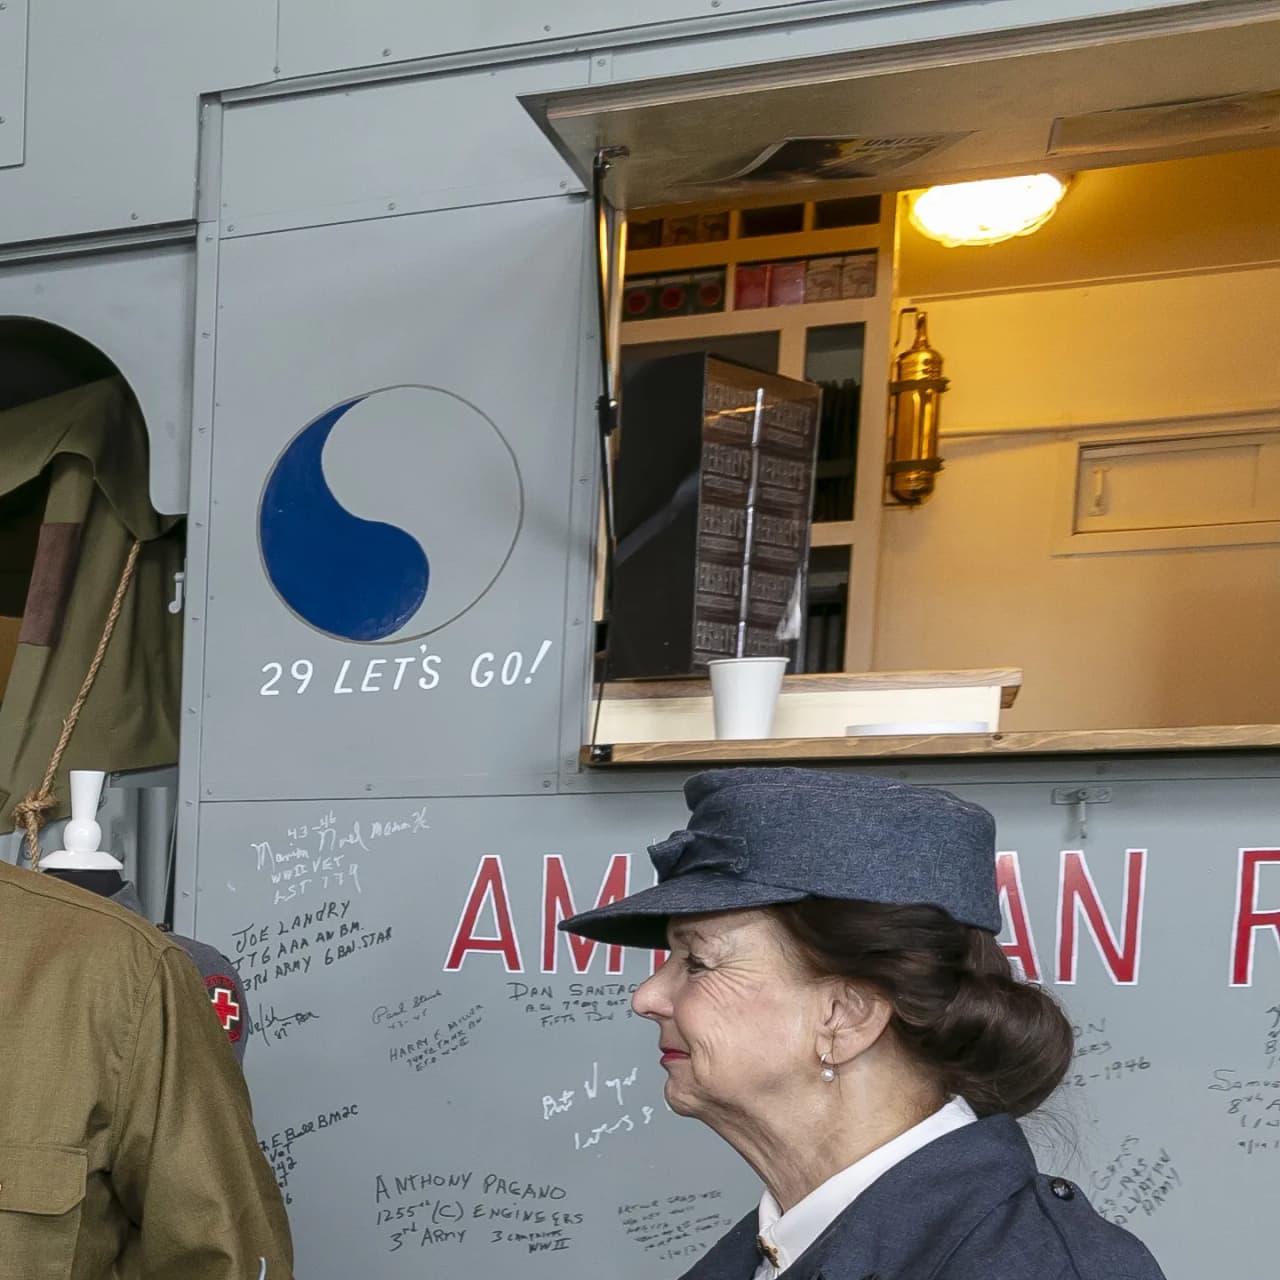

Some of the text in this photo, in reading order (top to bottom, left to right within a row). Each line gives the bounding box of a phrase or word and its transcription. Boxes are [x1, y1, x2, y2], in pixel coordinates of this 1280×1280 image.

[259, 640, 553, 697] 29 LET'S GO!
